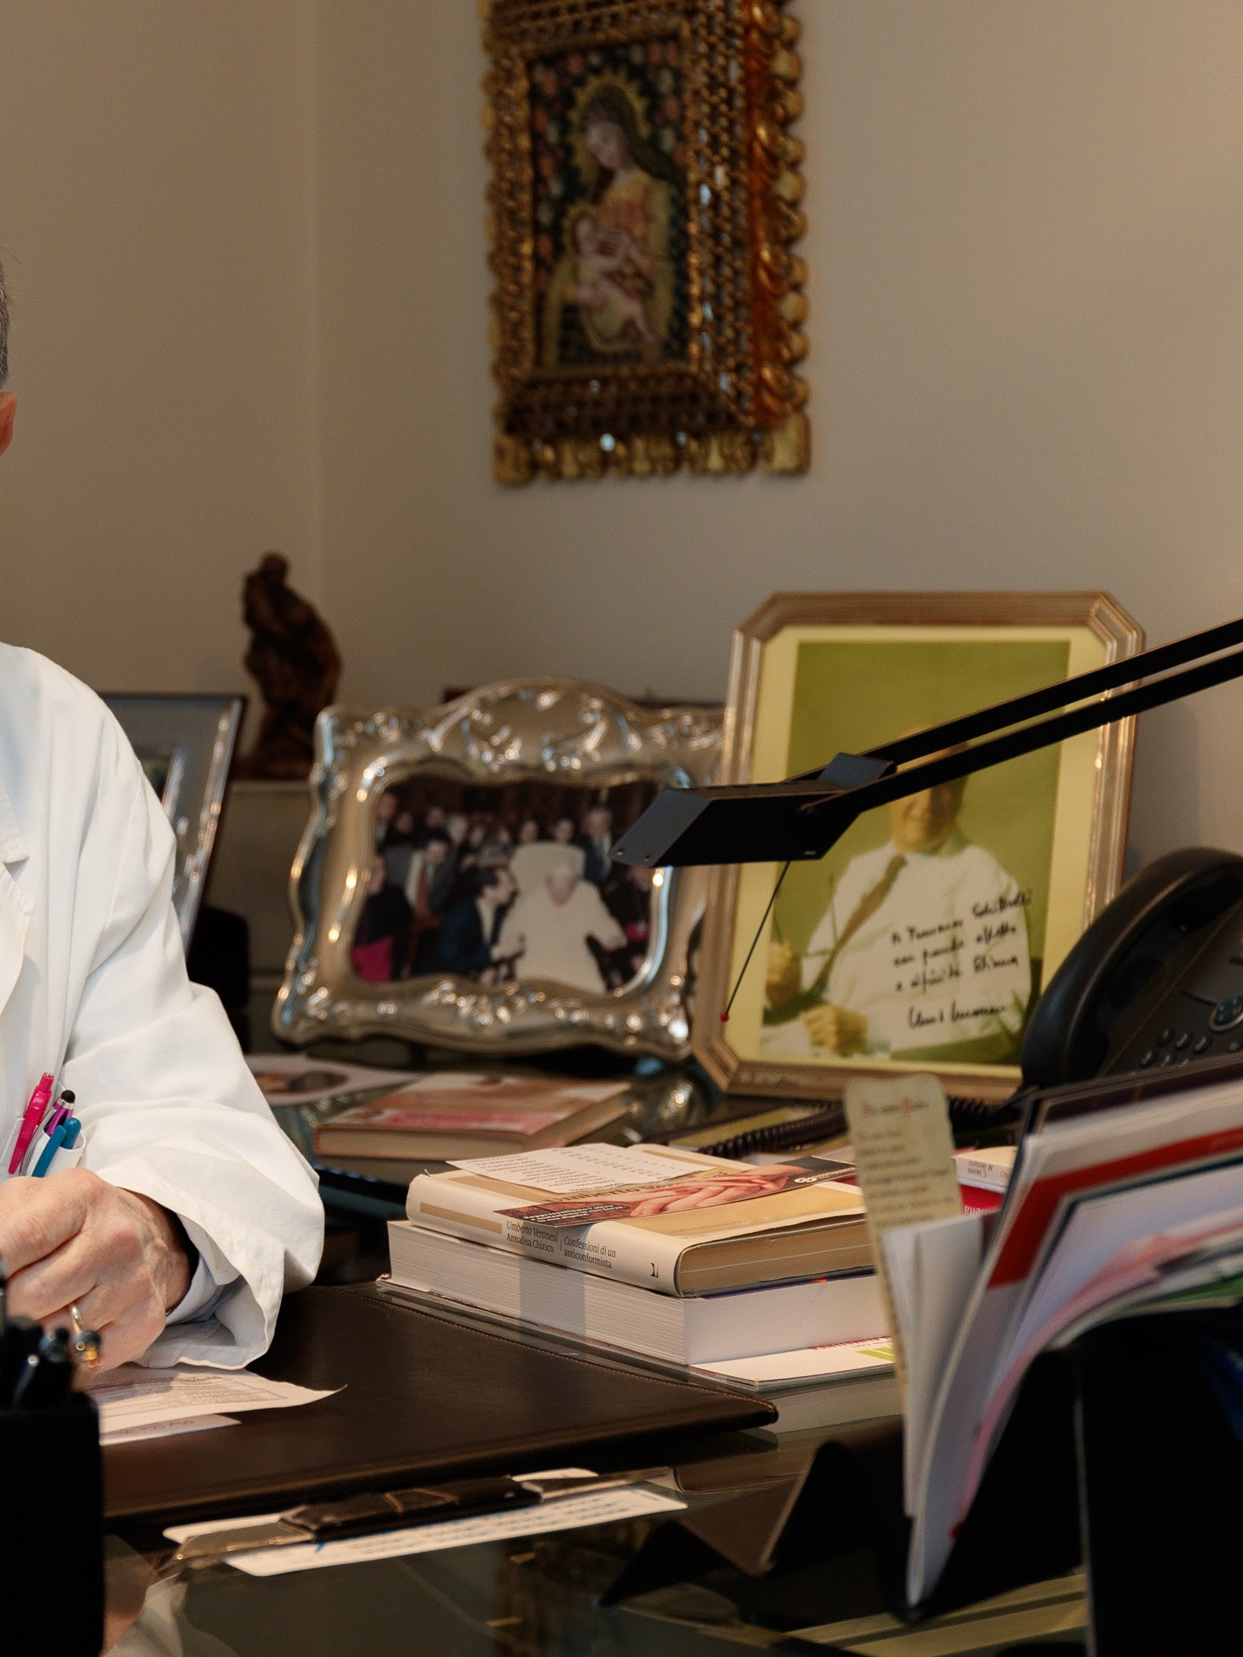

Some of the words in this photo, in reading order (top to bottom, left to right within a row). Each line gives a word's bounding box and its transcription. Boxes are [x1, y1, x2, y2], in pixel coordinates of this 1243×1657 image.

[507, 1221, 532, 1236] Umberto
[533, 1227, 558, 1243] Veronesi
[507, 1233, 531, 1247] Annalisa
[532, 1239, 554, 1253] Chirico
[564, 1236, 600, 1253] Confessioni
[600, 1244, 607, 1256] di
[607, 1249, 616, 1258] un
[564, 1249, 612, 1269] anticonformista
